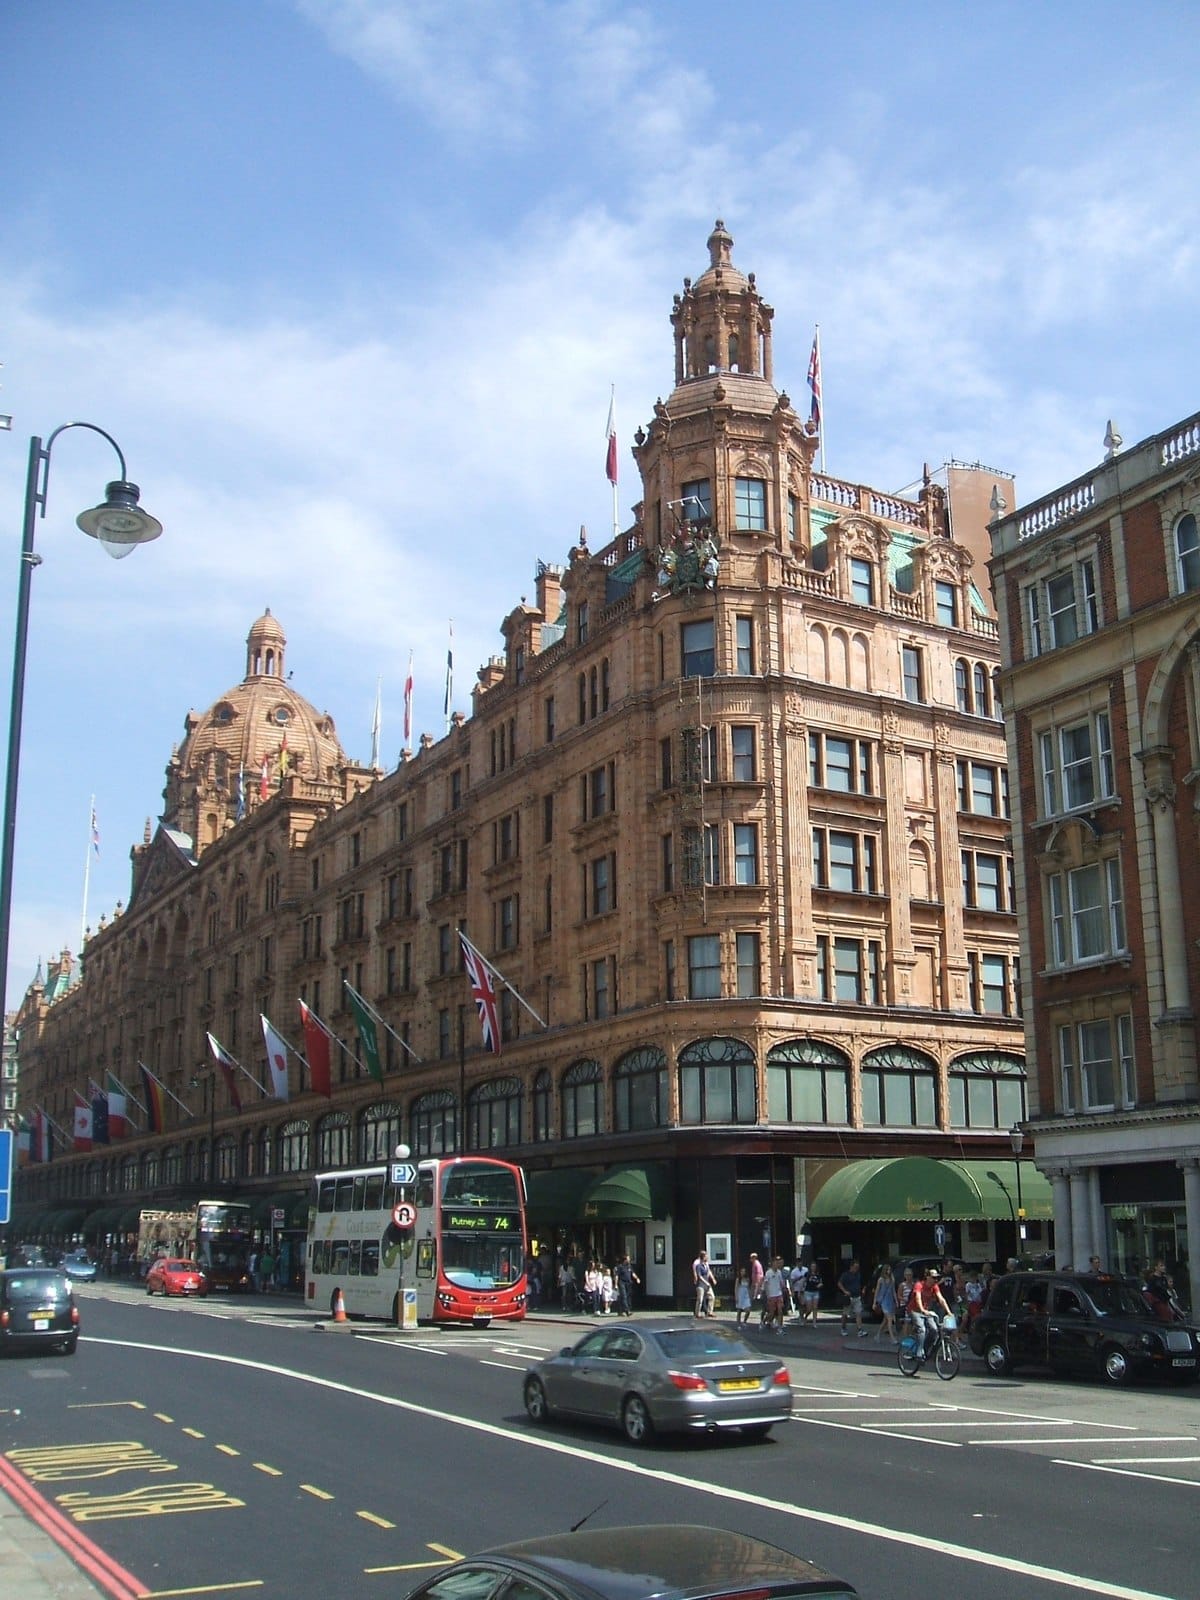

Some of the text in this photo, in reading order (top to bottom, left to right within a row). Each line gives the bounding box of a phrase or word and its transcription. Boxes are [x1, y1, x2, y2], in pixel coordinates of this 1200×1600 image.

[451, 1217, 477, 1228] Putney
[495, 1217, 509, 1230] 74
[55, 1482, 247, 1522] BUS
